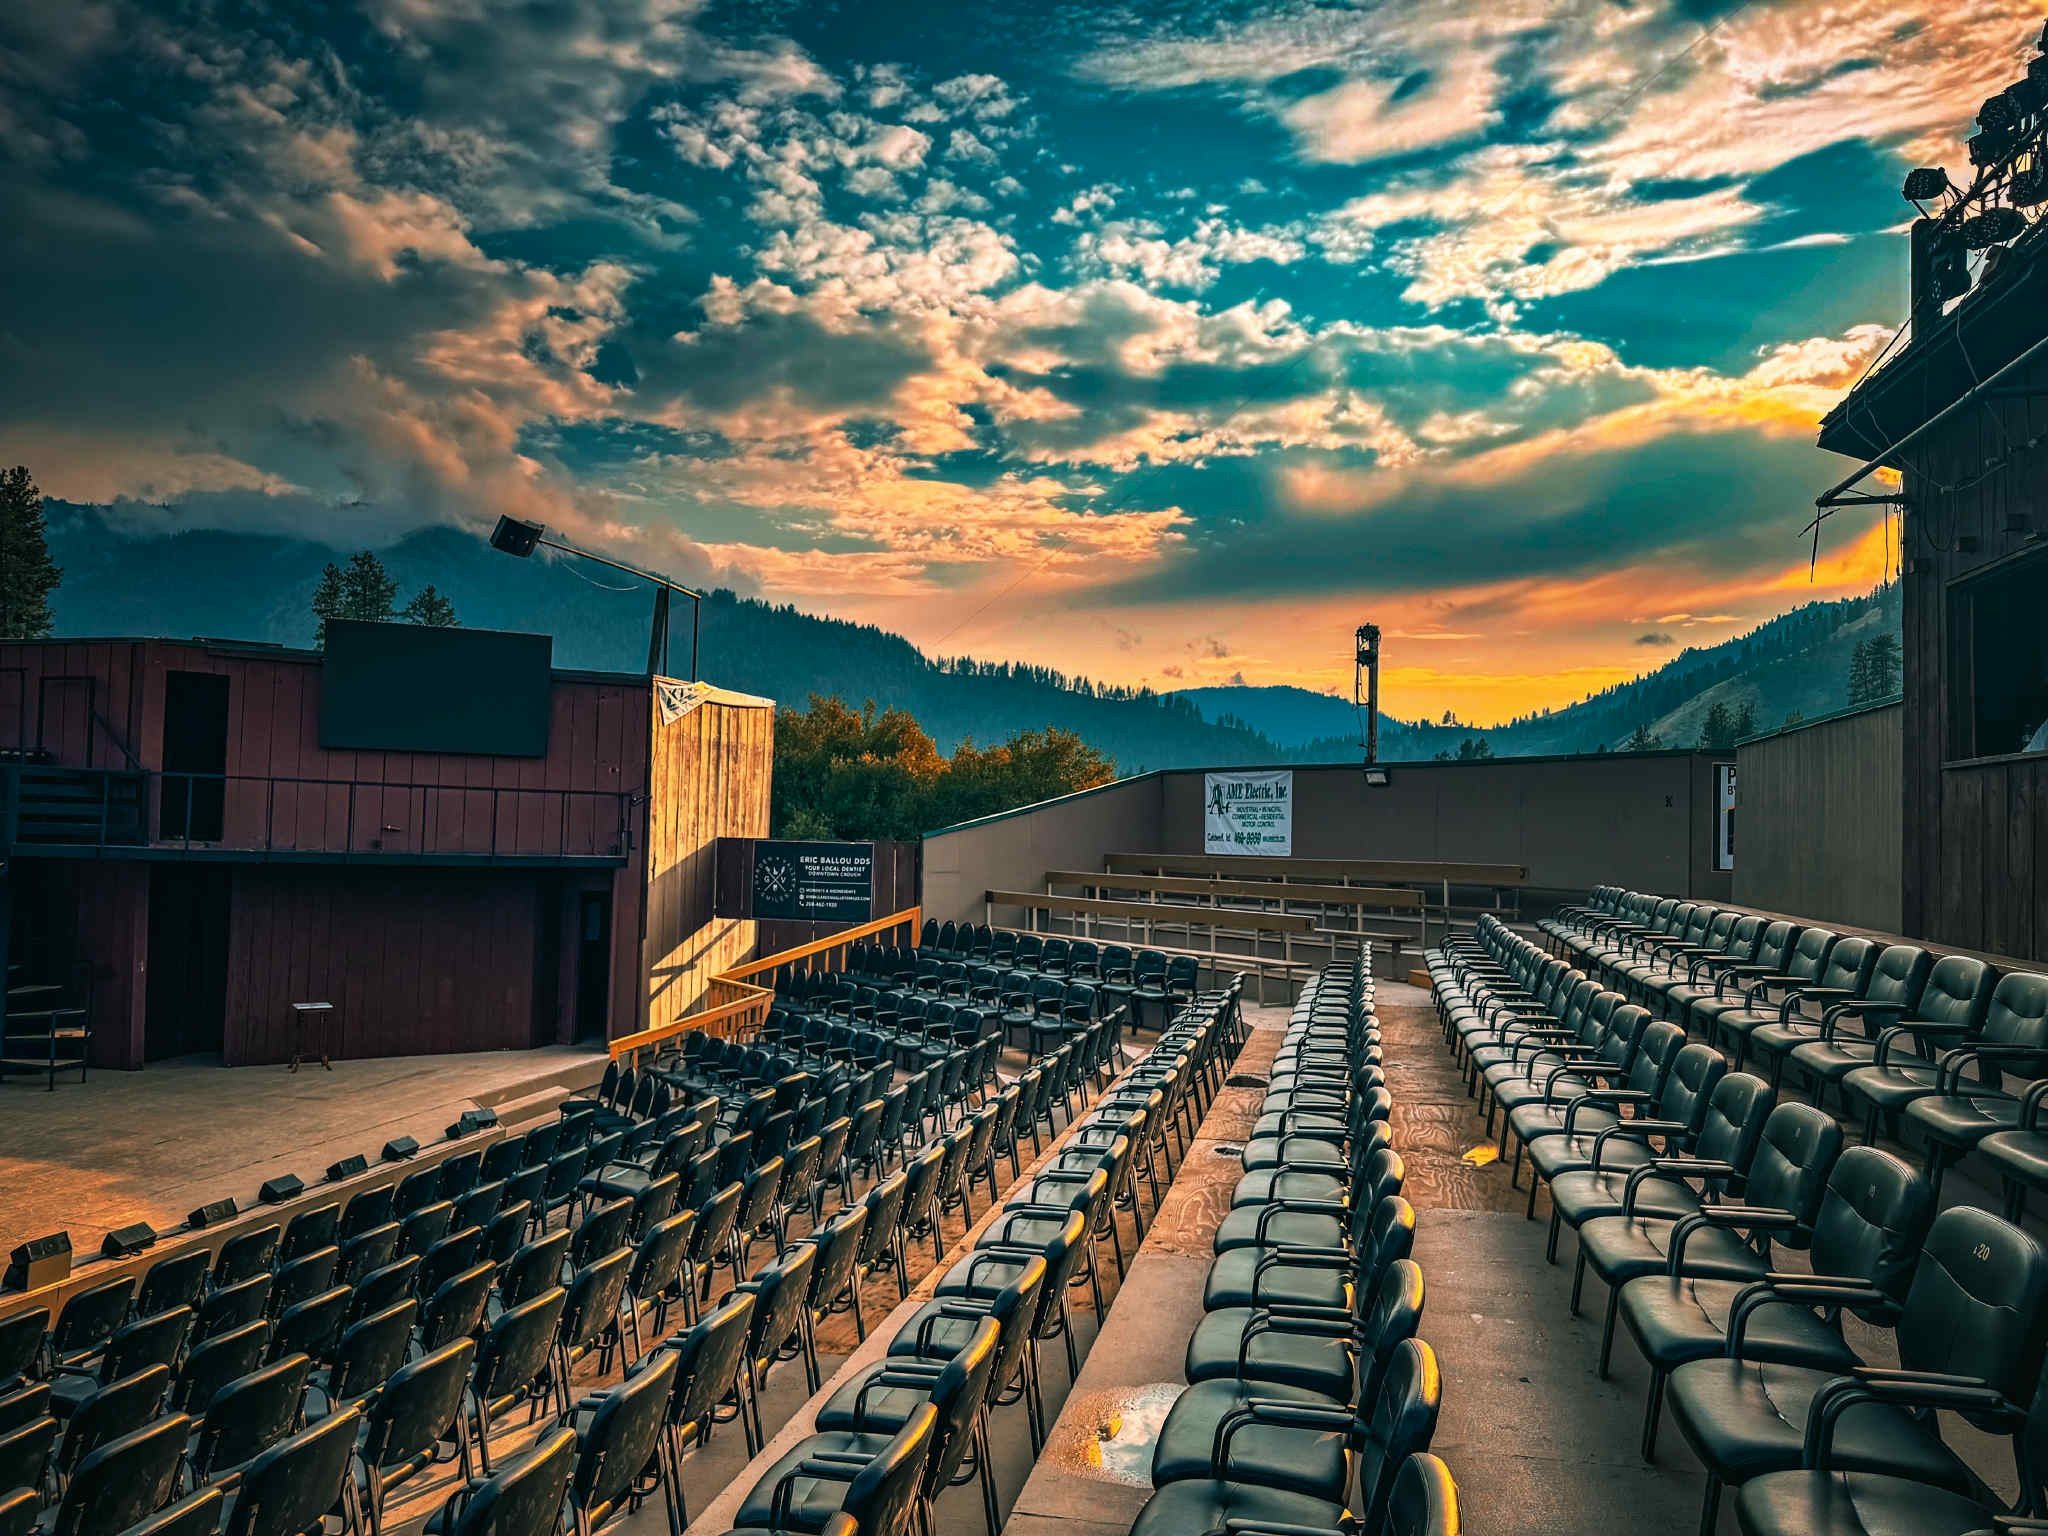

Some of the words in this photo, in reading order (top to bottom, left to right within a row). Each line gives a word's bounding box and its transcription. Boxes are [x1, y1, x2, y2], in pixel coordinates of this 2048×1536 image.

[1226, 783, 1242, 799] AME
[1275, 782, 1288, 799] Inc.
[799, 856, 818, 864] ERIC
[820, 856, 851, 864] BALLOU
[854, 857, 871, 865] DDS
